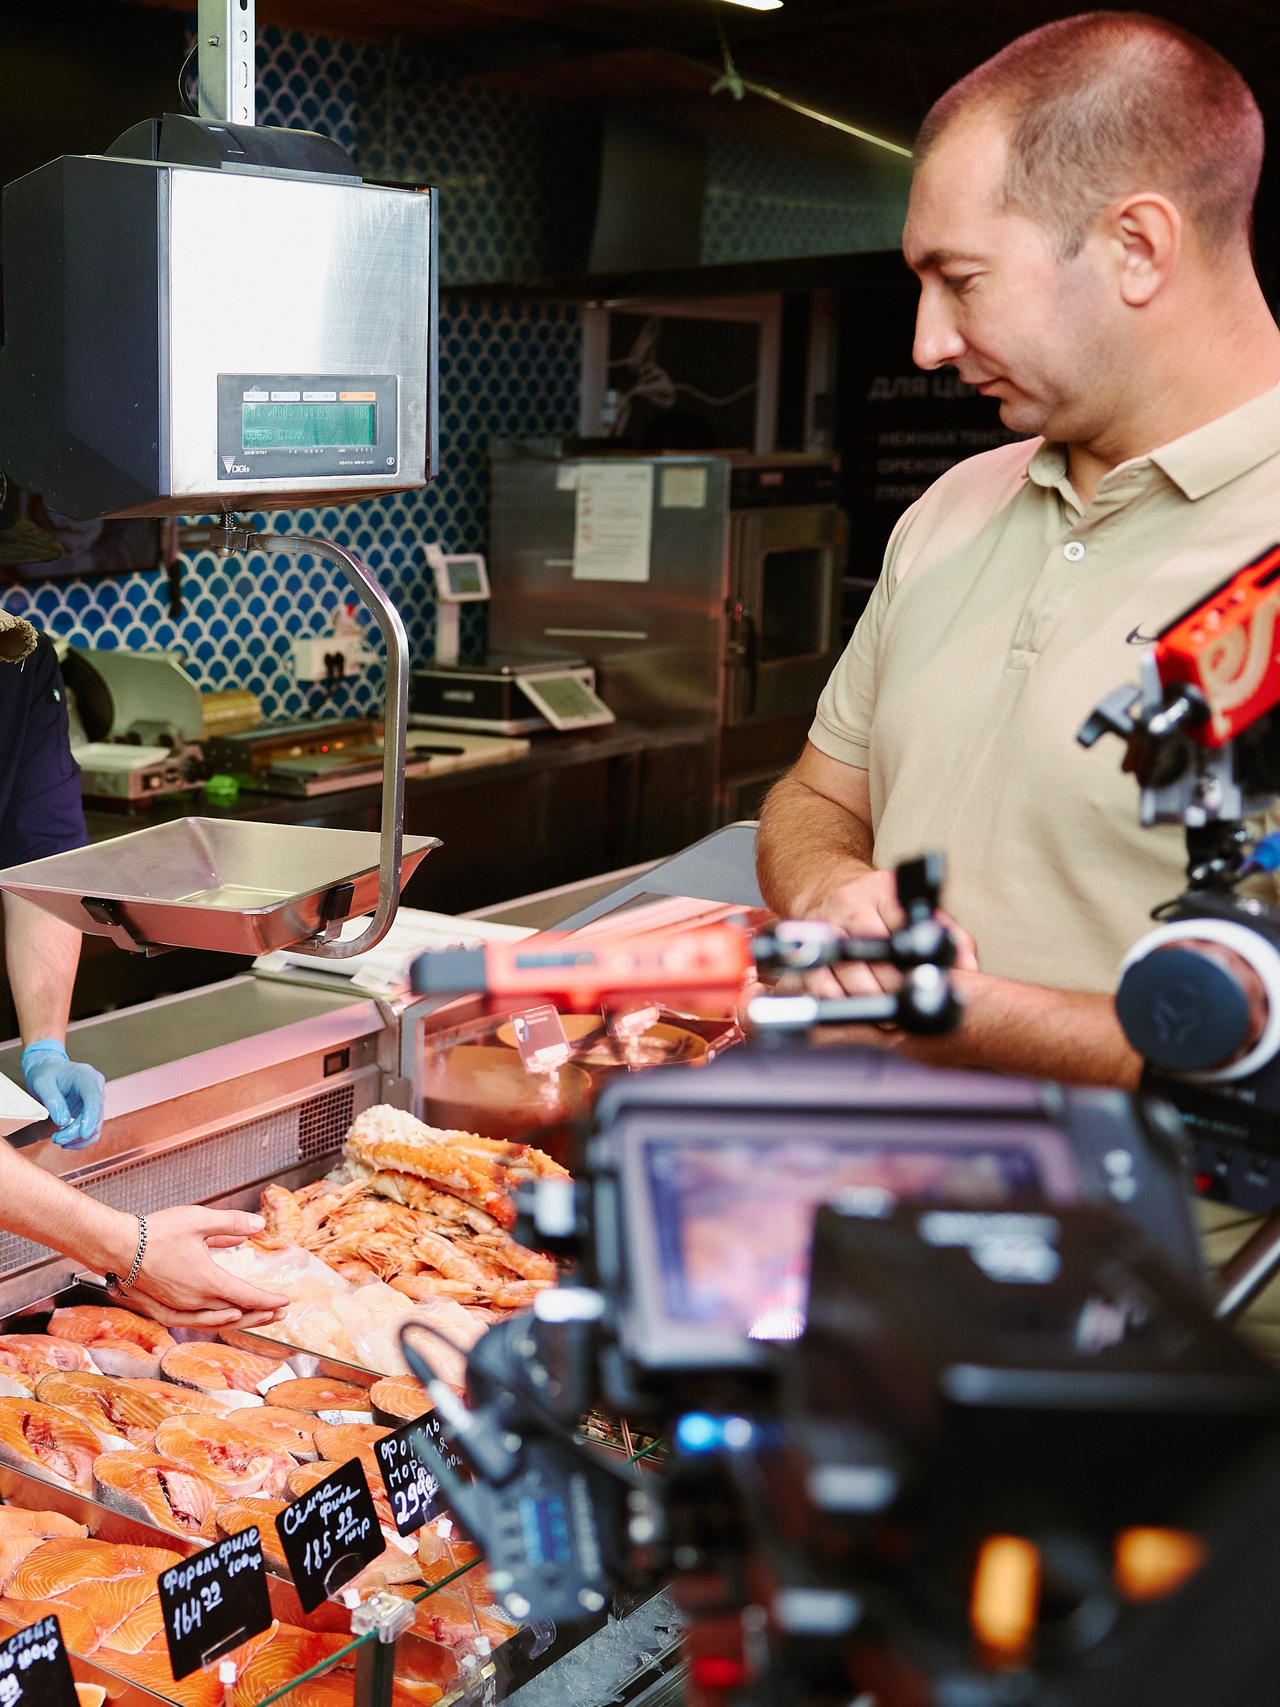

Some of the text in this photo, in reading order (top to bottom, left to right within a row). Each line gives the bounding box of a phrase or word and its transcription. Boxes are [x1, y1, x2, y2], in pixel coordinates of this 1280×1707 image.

[163, 1528, 261, 1596] Форель филе
[303, 1531, 332, 1575] 185
[173, 1597, 202, 1641] 164
